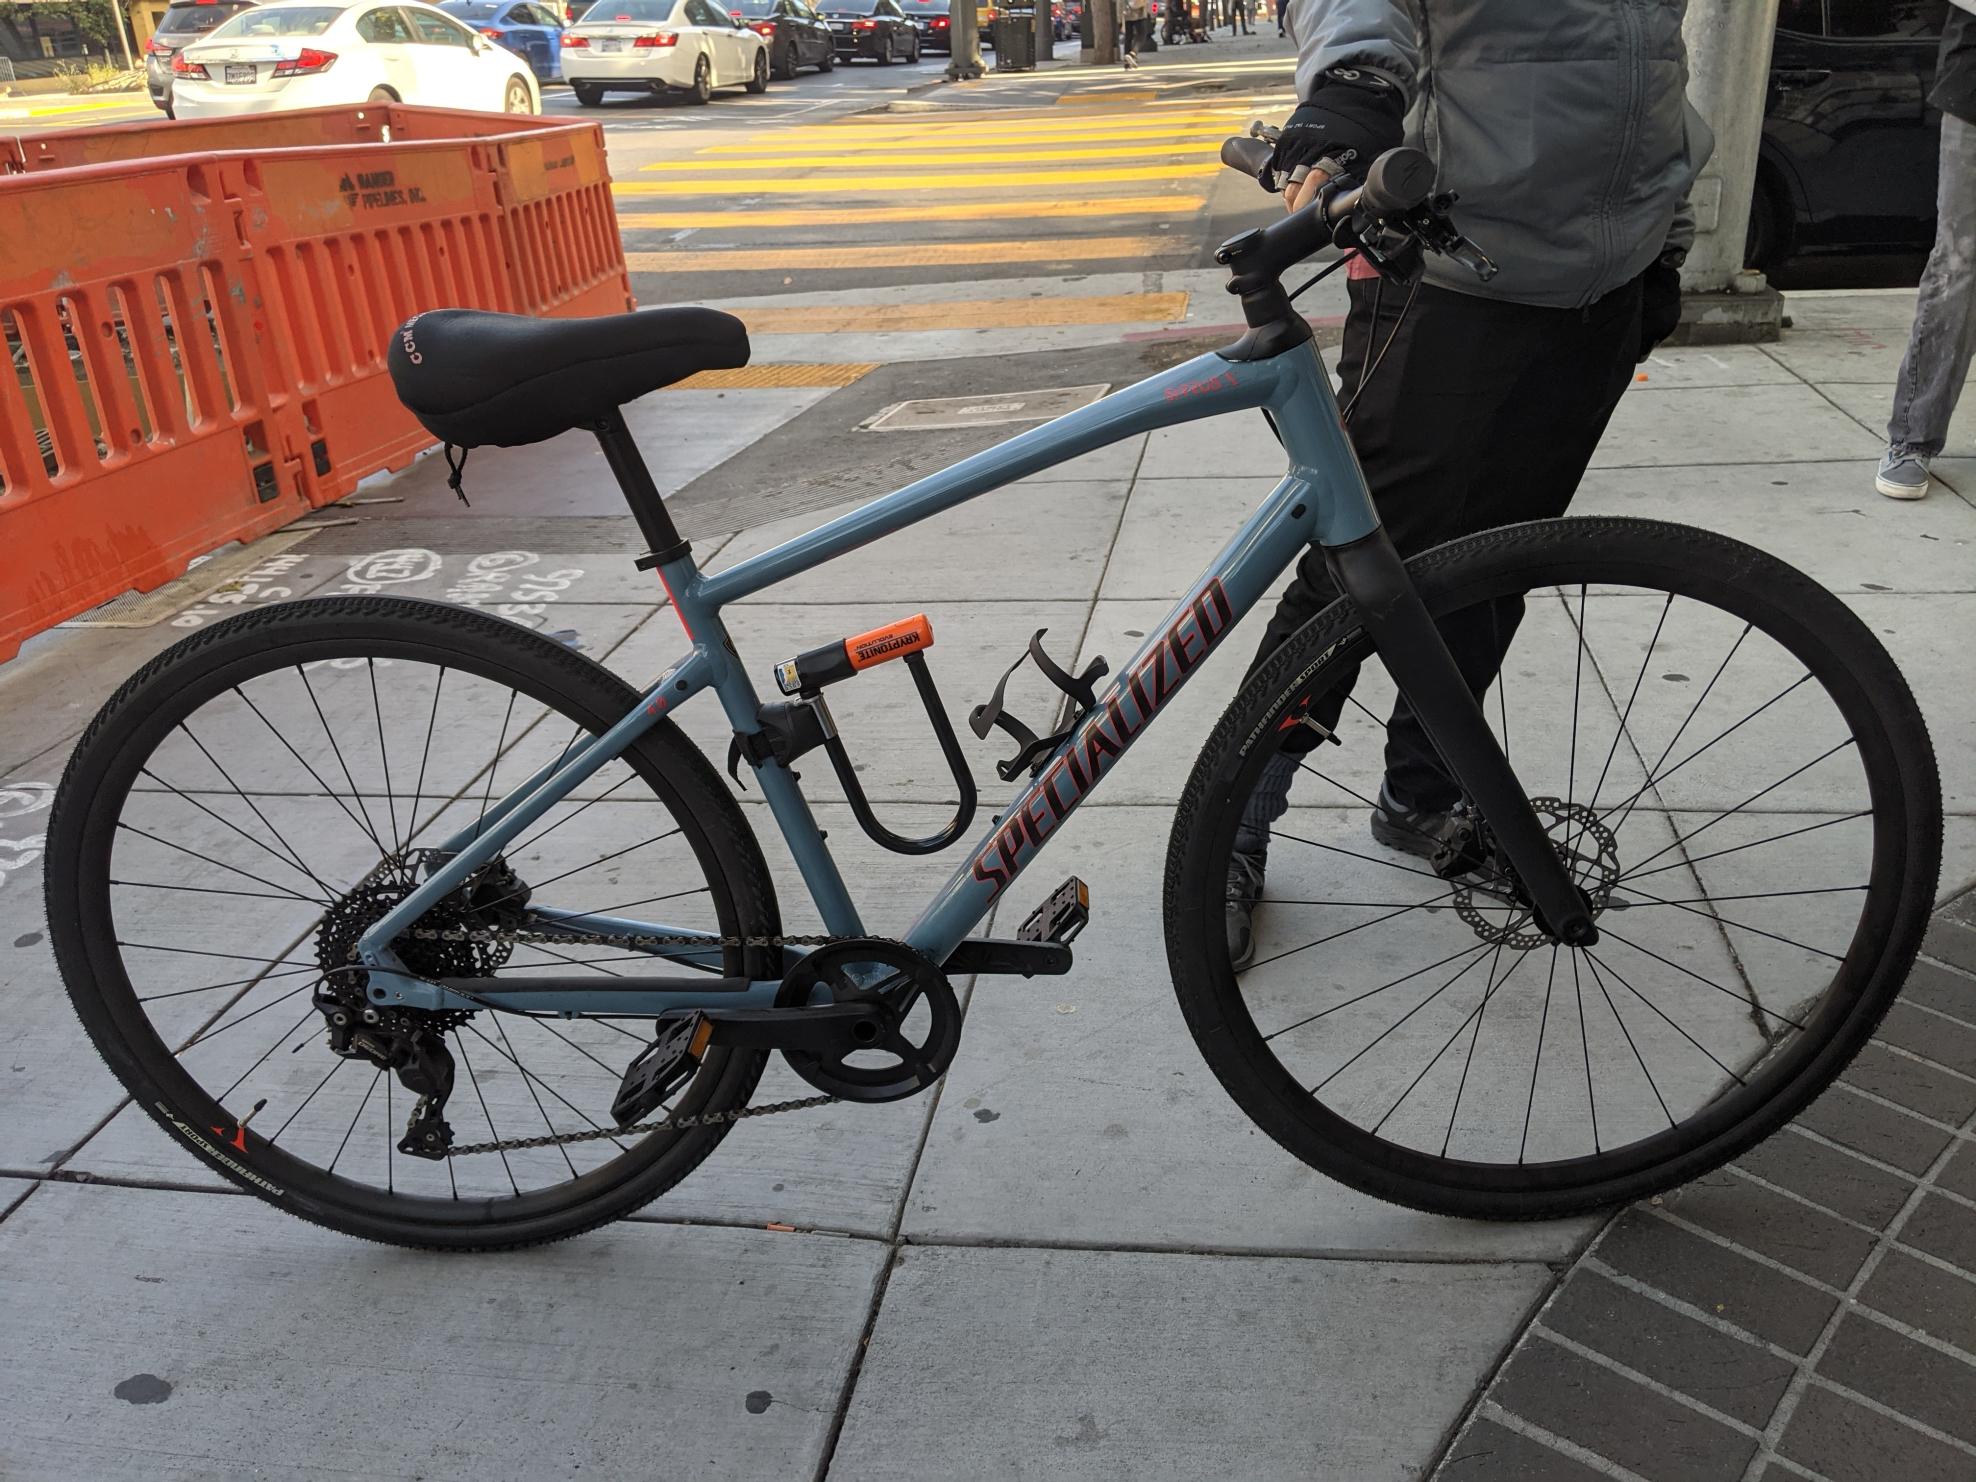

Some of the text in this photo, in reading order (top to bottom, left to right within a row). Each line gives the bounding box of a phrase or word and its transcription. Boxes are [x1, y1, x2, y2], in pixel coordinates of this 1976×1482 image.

[856, 633, 894, 650] EVOLUTION
[857, 631, 920, 662] KRYPTONITE
[972, 575, 1233, 904] SPECIALIZED
[1239, 650, 1332, 757] PATHFINDER SPORT
[179, 1123, 285, 1197] PATHFINDER SPORT
